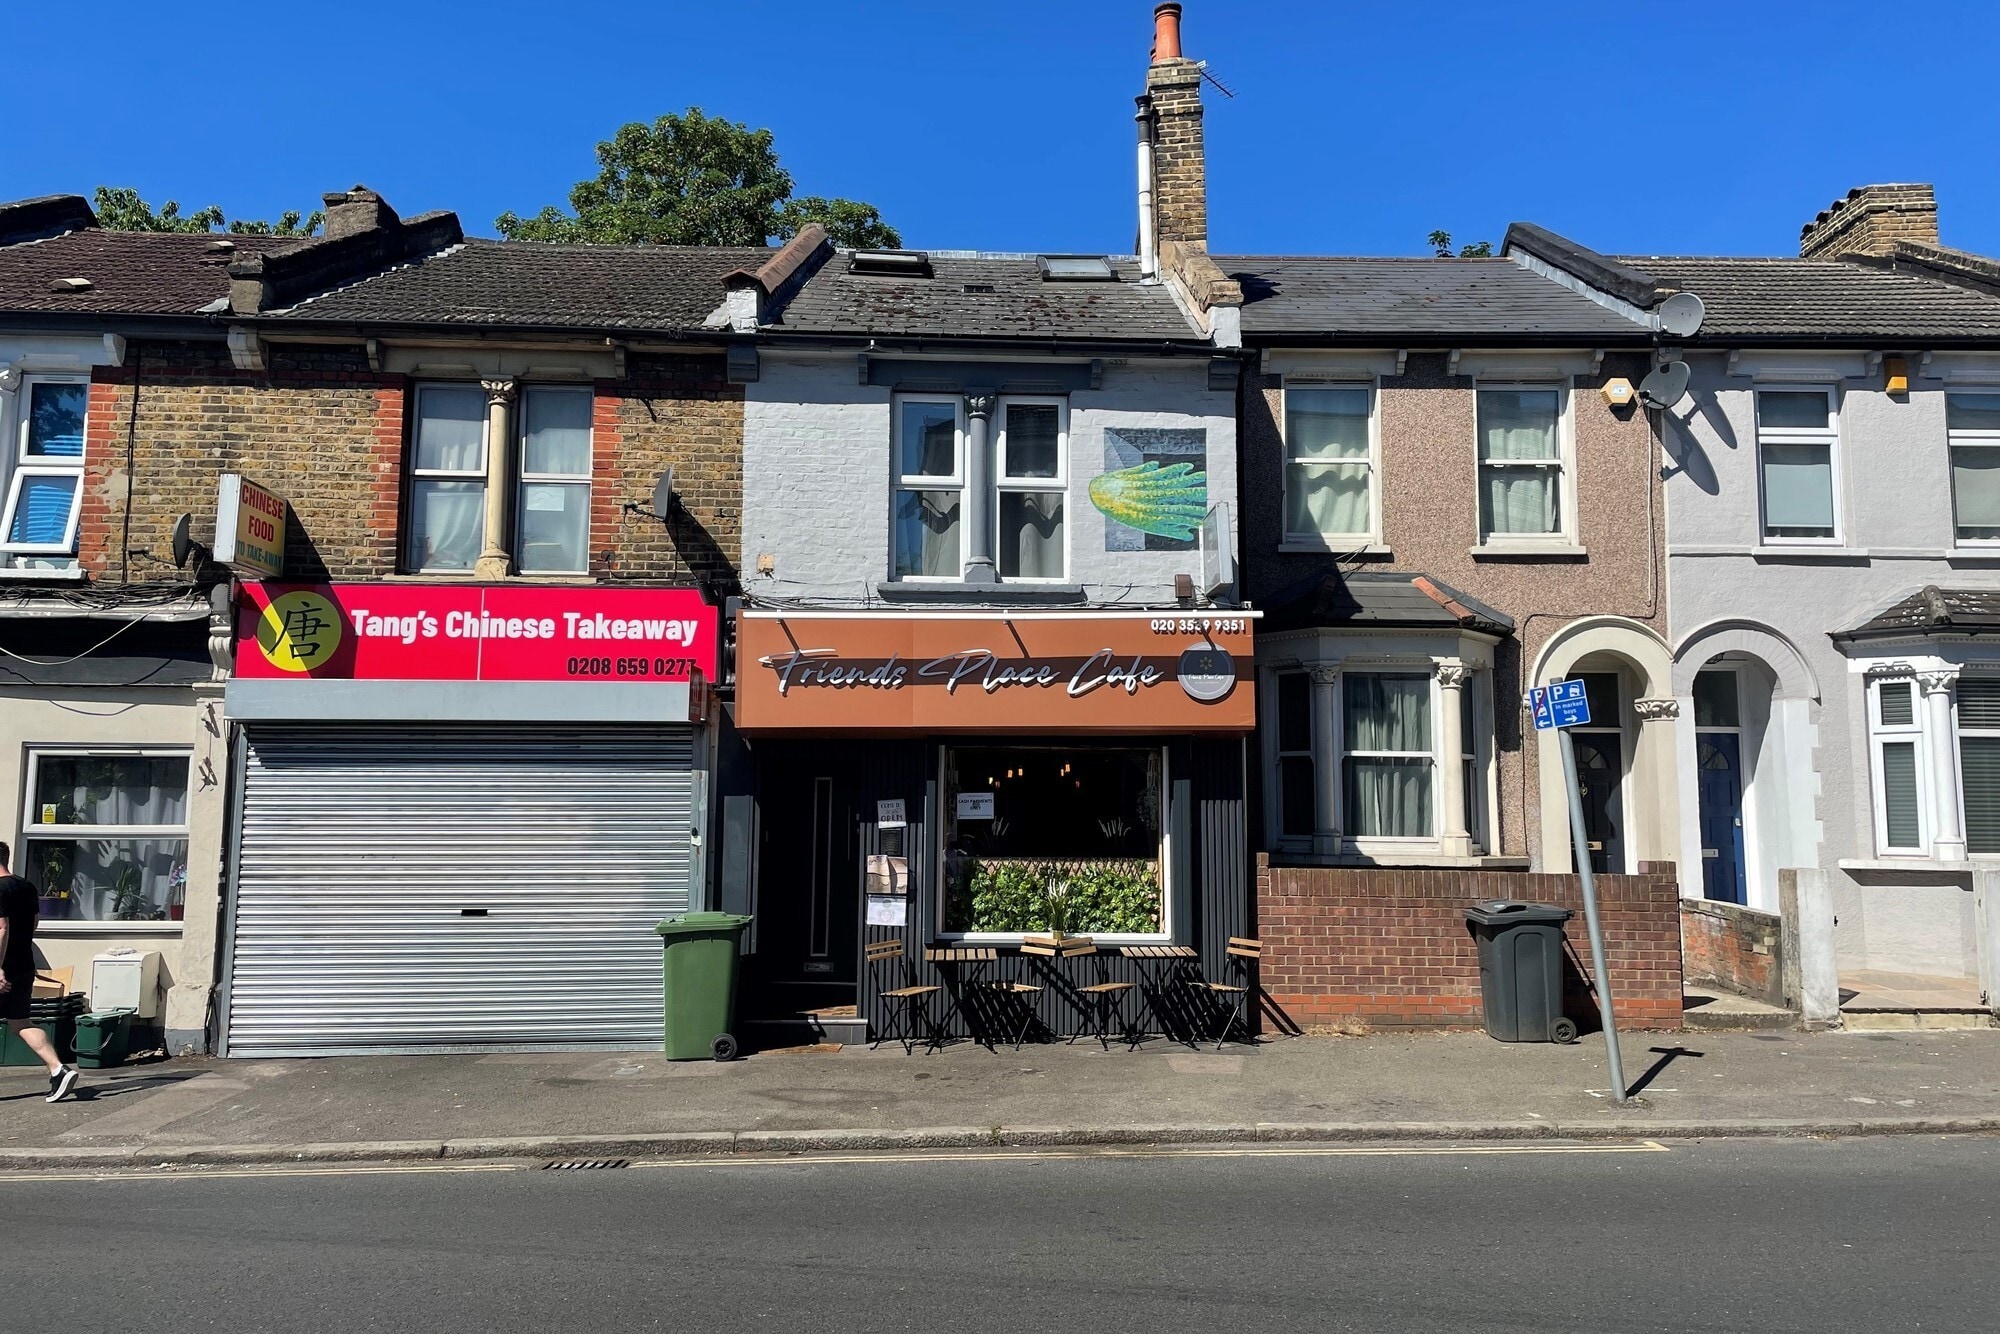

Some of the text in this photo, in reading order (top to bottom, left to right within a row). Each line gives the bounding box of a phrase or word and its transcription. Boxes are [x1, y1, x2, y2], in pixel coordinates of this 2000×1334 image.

[242, 484, 284, 521] CHINESE
[248, 514, 274, 543] FOOD
[237, 539, 282, 569] TO TAKE-AWAY
[266, 600, 331, 660] 唐
[350, 609, 698, 647] Tang's Chinese Takeaway
[1150, 619, 1175, 631] 020
[1214, 619, 1245, 631] 9351
[567, 657, 611, 675] 0208
[616, 657, 649, 675] 659
[758, 647, 1165, 694] Friends Place Cafe
[1553, 686, 1563, 700] P
[1562, 701, 1583, 709] marked
[880, 814, 903, 822] OPEN
